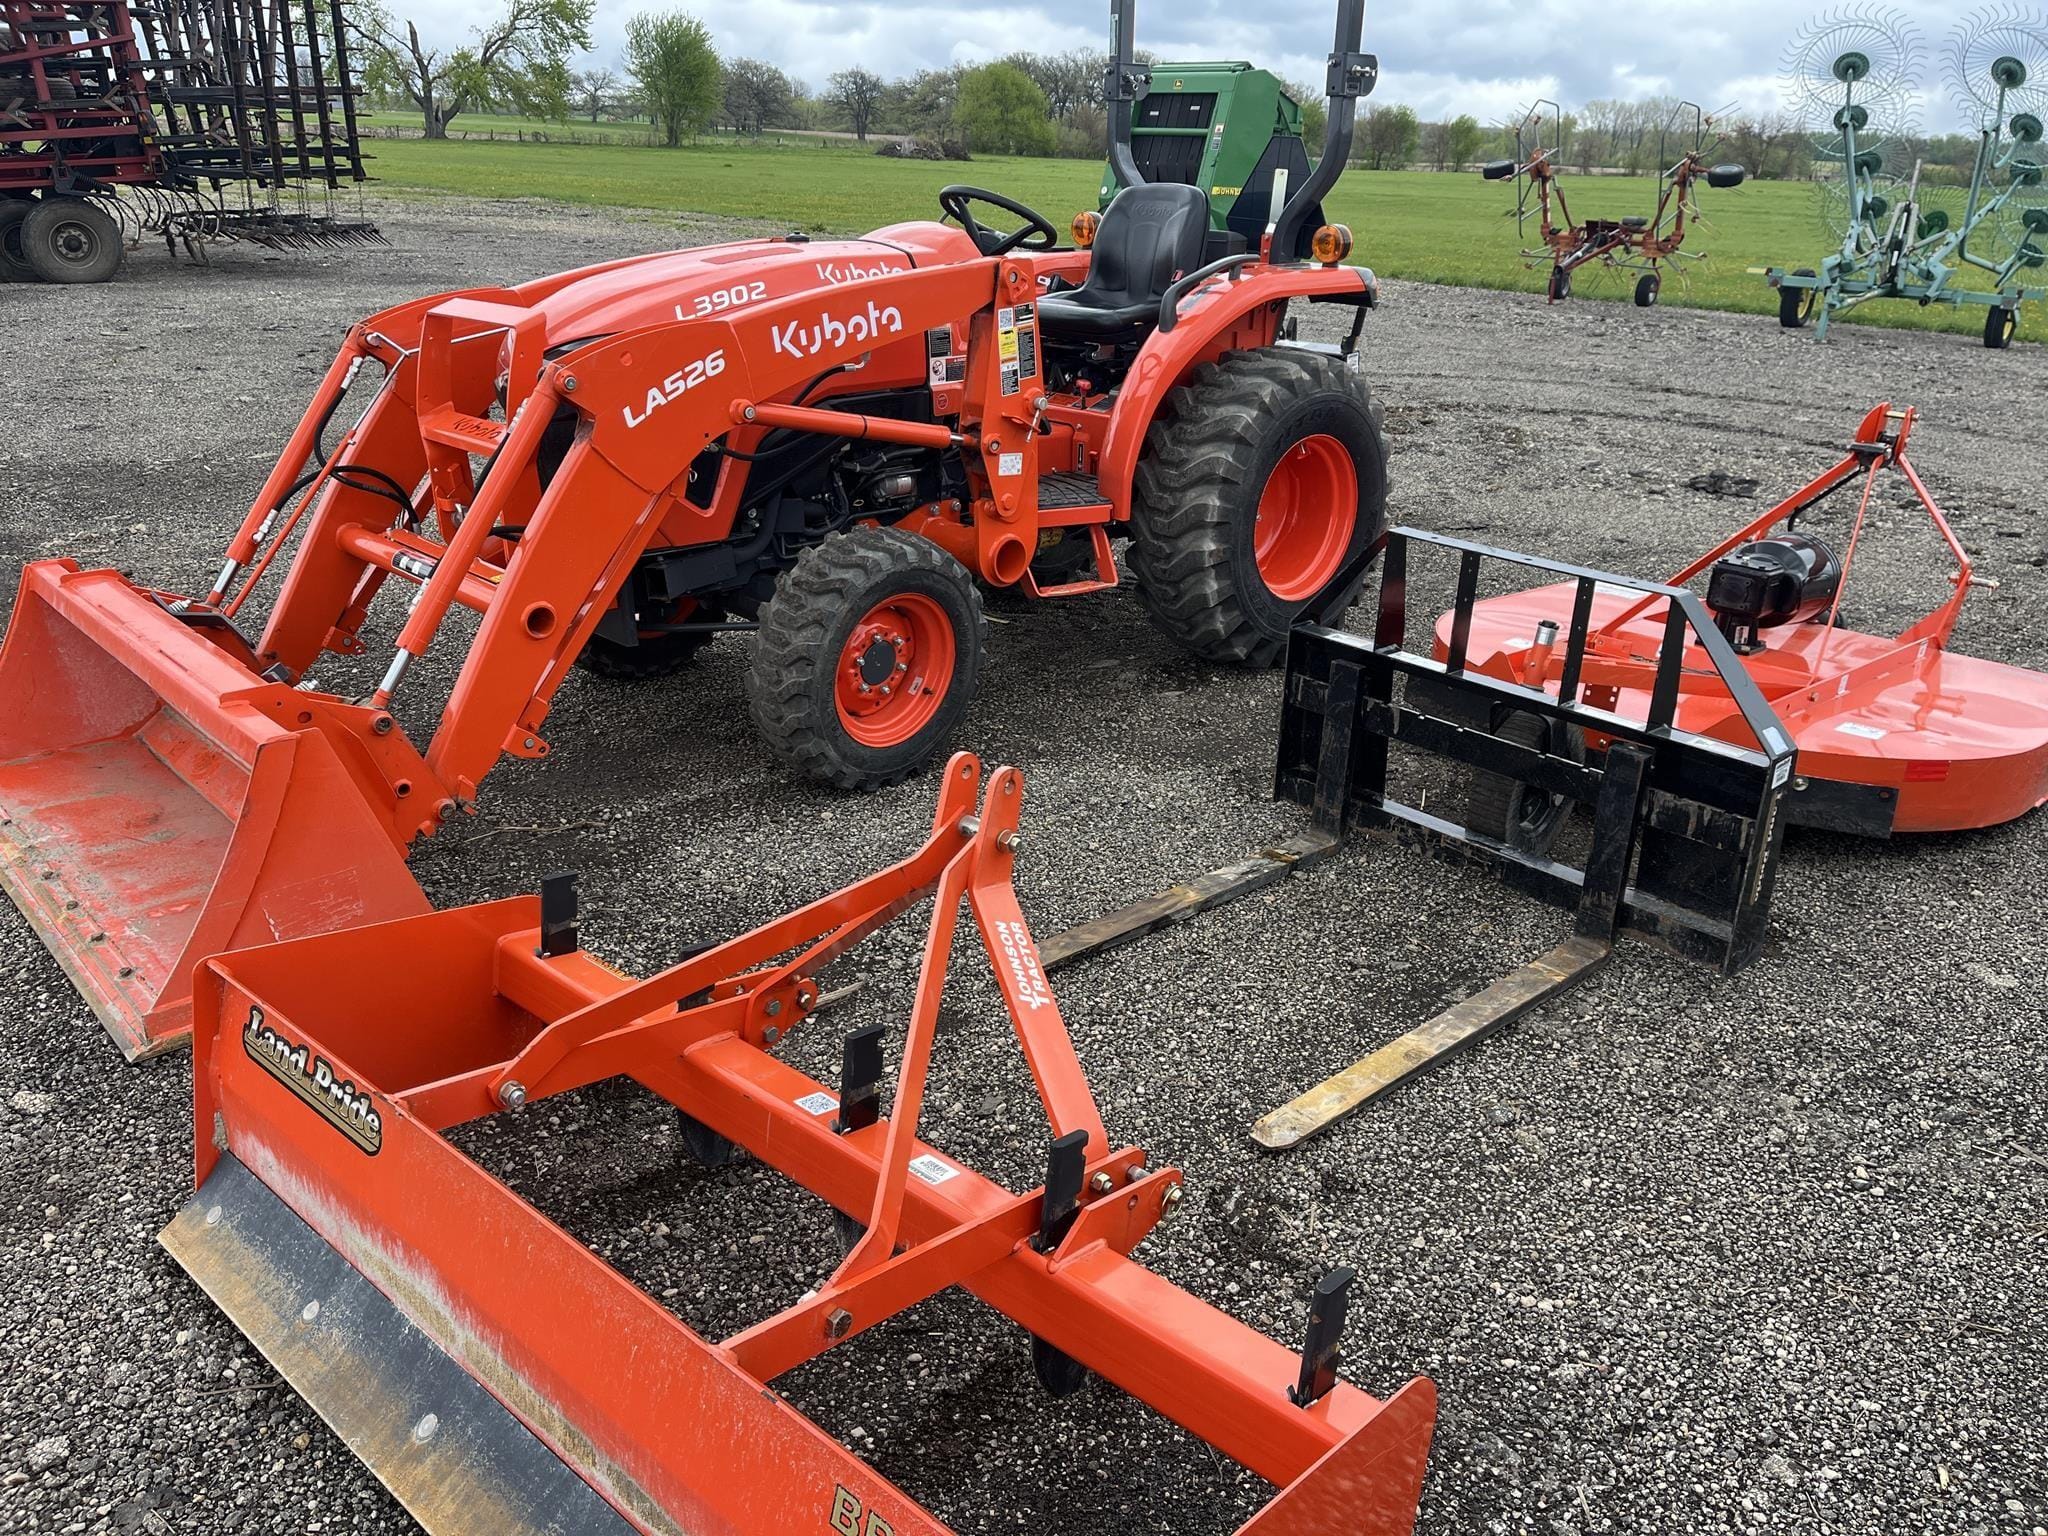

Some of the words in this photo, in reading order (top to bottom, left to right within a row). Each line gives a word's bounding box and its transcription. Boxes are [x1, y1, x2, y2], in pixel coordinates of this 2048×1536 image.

[675, 281, 767, 320] L3902
[771, 301, 903, 358] Kubota
[622, 349, 726, 428] LA526
[995, 920, 1038, 1010] JOHNSON
[1009, 921, 1051, 1007] TRACTOR
[247, 1009, 308, 1080] Land
[310, 1059, 380, 1139] Pride
